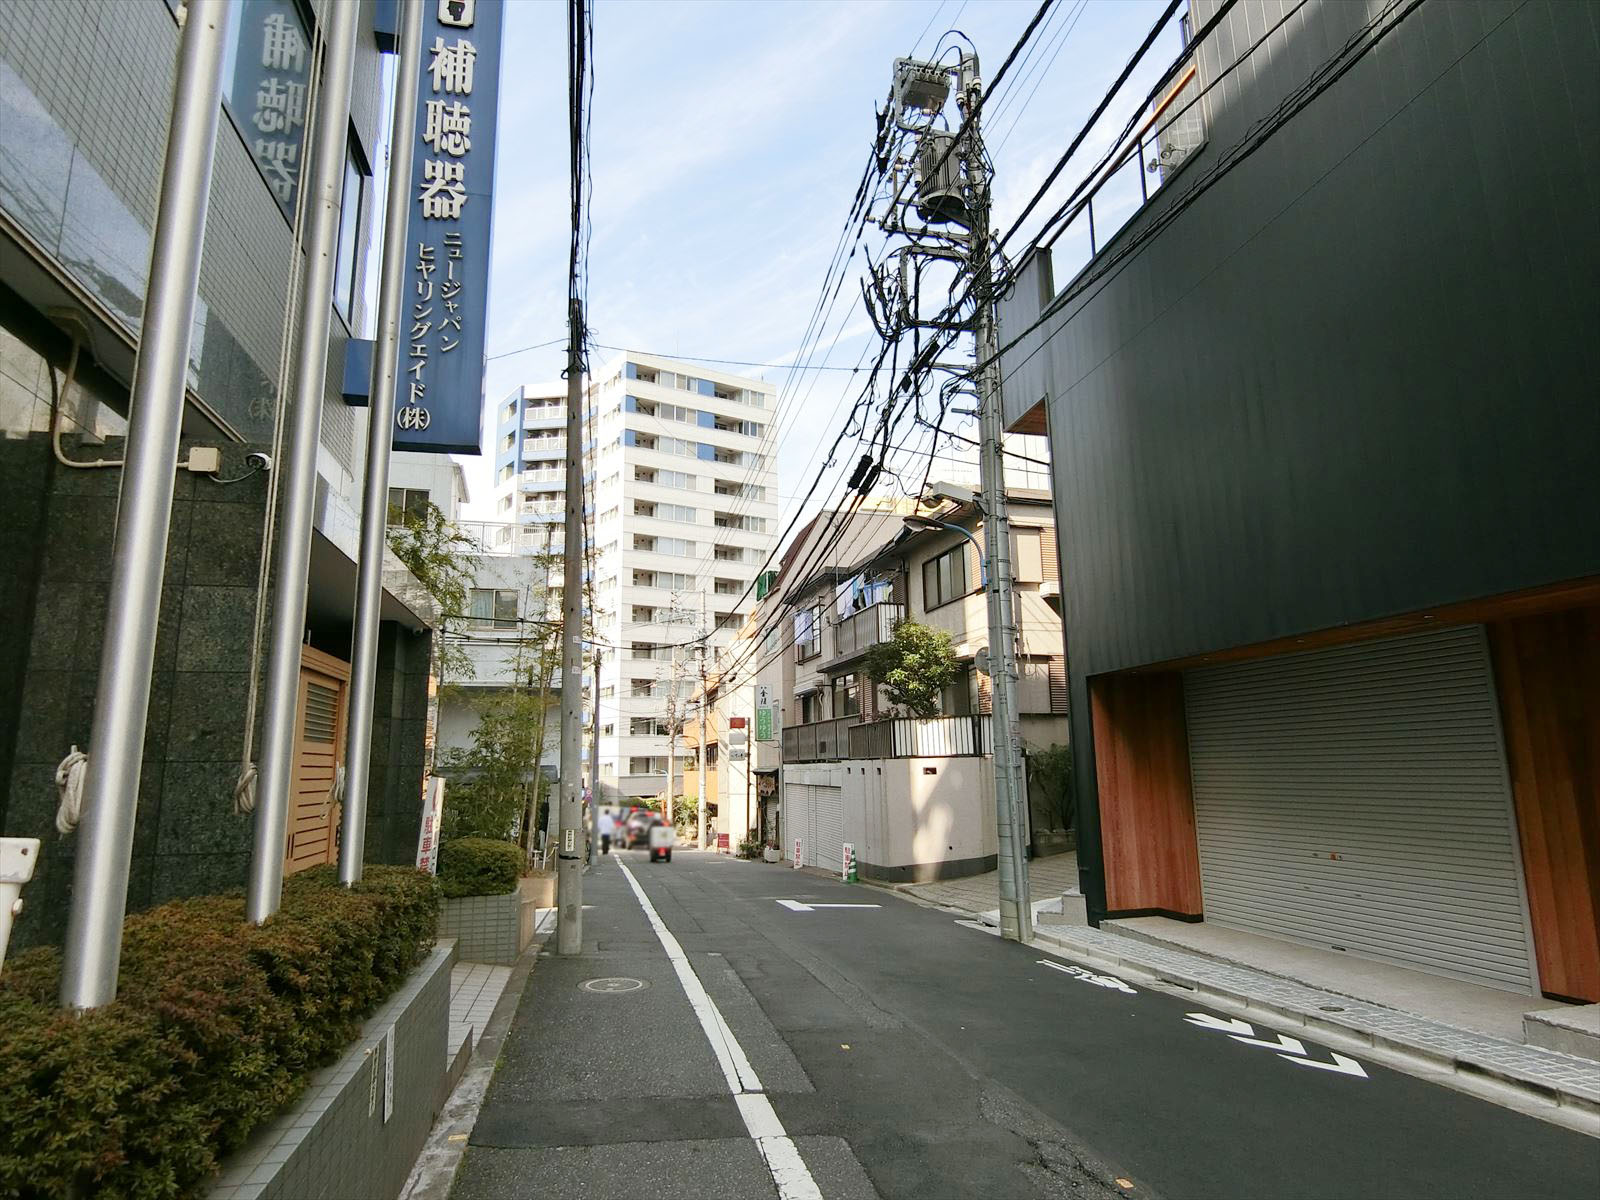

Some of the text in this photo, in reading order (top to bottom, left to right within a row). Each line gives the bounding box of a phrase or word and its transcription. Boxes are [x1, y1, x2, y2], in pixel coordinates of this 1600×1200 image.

[418, 36, 477, 220] 補聴器
[437, 231, 463, 353] ニュージャパン
